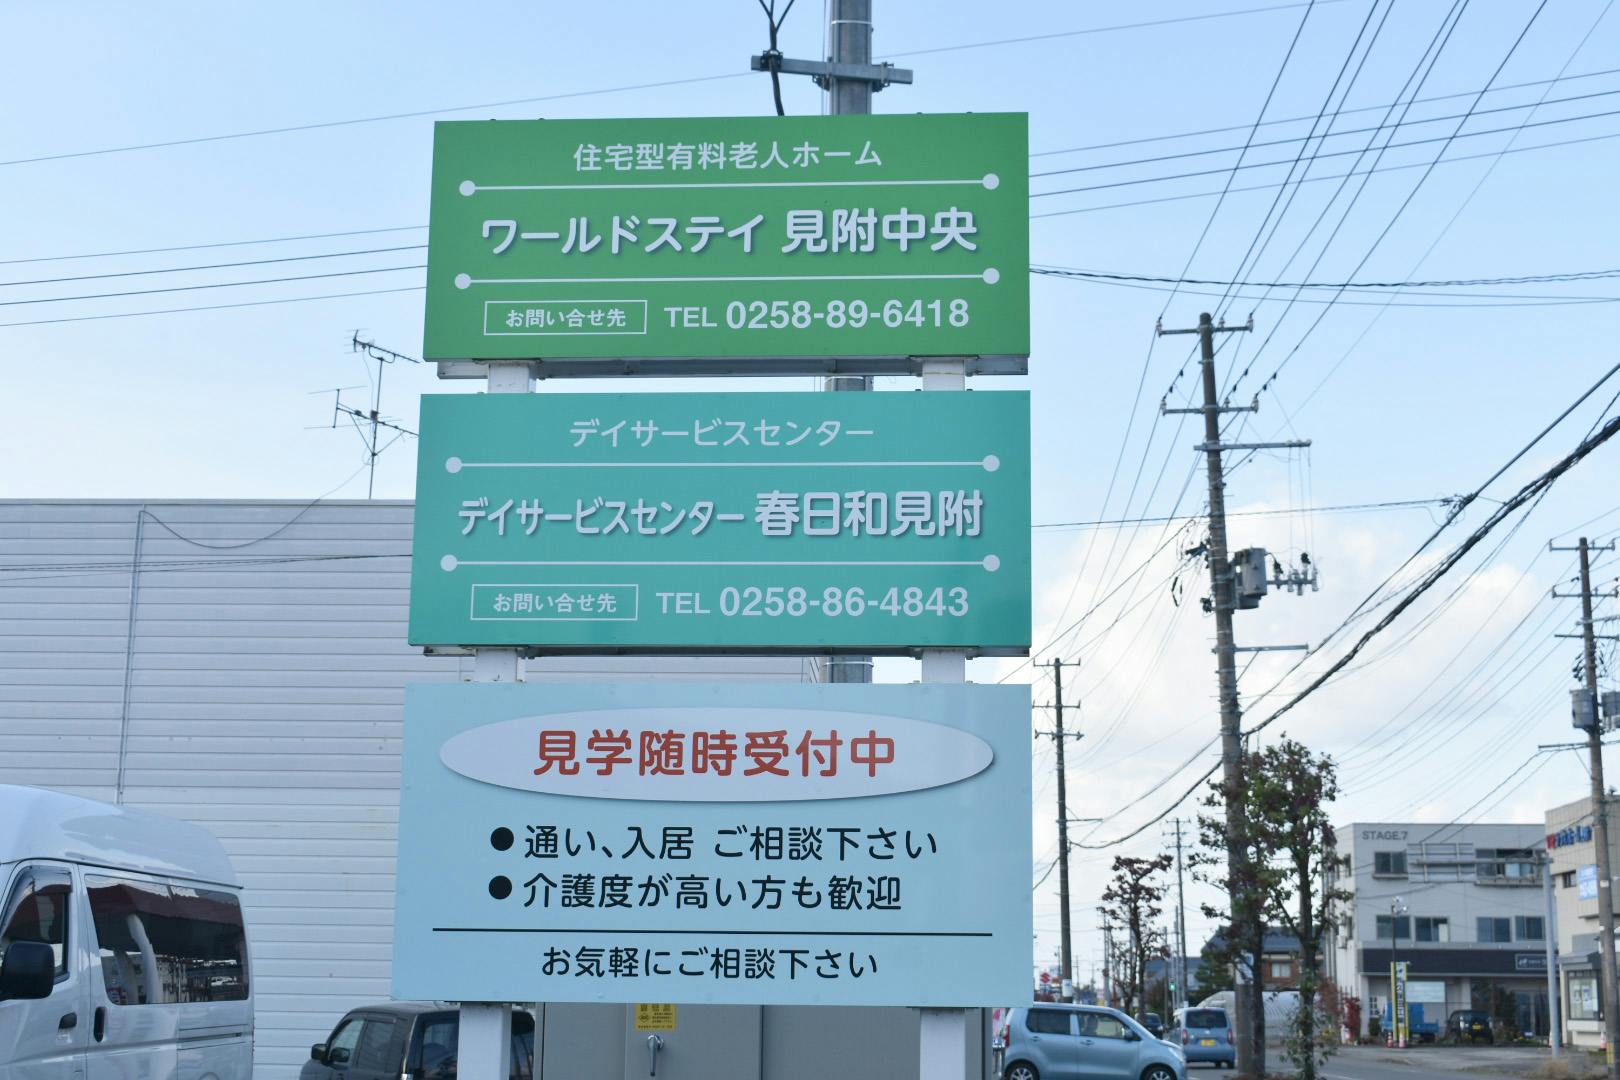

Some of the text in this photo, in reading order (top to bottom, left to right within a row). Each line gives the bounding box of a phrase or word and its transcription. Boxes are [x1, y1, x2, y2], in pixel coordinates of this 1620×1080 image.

[574, 141, 881, 171] 住宅型有料老人ホーム
[483, 207, 976, 254] ワールドステイ 見附中央
[505, 299, 969, 329] お問い合せ先 TEL 0258-89-6418
[571, 418, 873, 447] デイサービスセンター
[459, 490, 982, 536] デイサービスセンター 春日和見附
[494, 587, 969, 616] お問い合せ先 TEL 0258-86-4843
[534, 731, 895, 777] 見学随時受付中
[525, 825, 937, 861] 通い、入居 ご相談下さい
[524, 873, 901, 910] 介護度が高い方も歓迎
[542, 946, 878, 979] お気軽にご相談下さい
